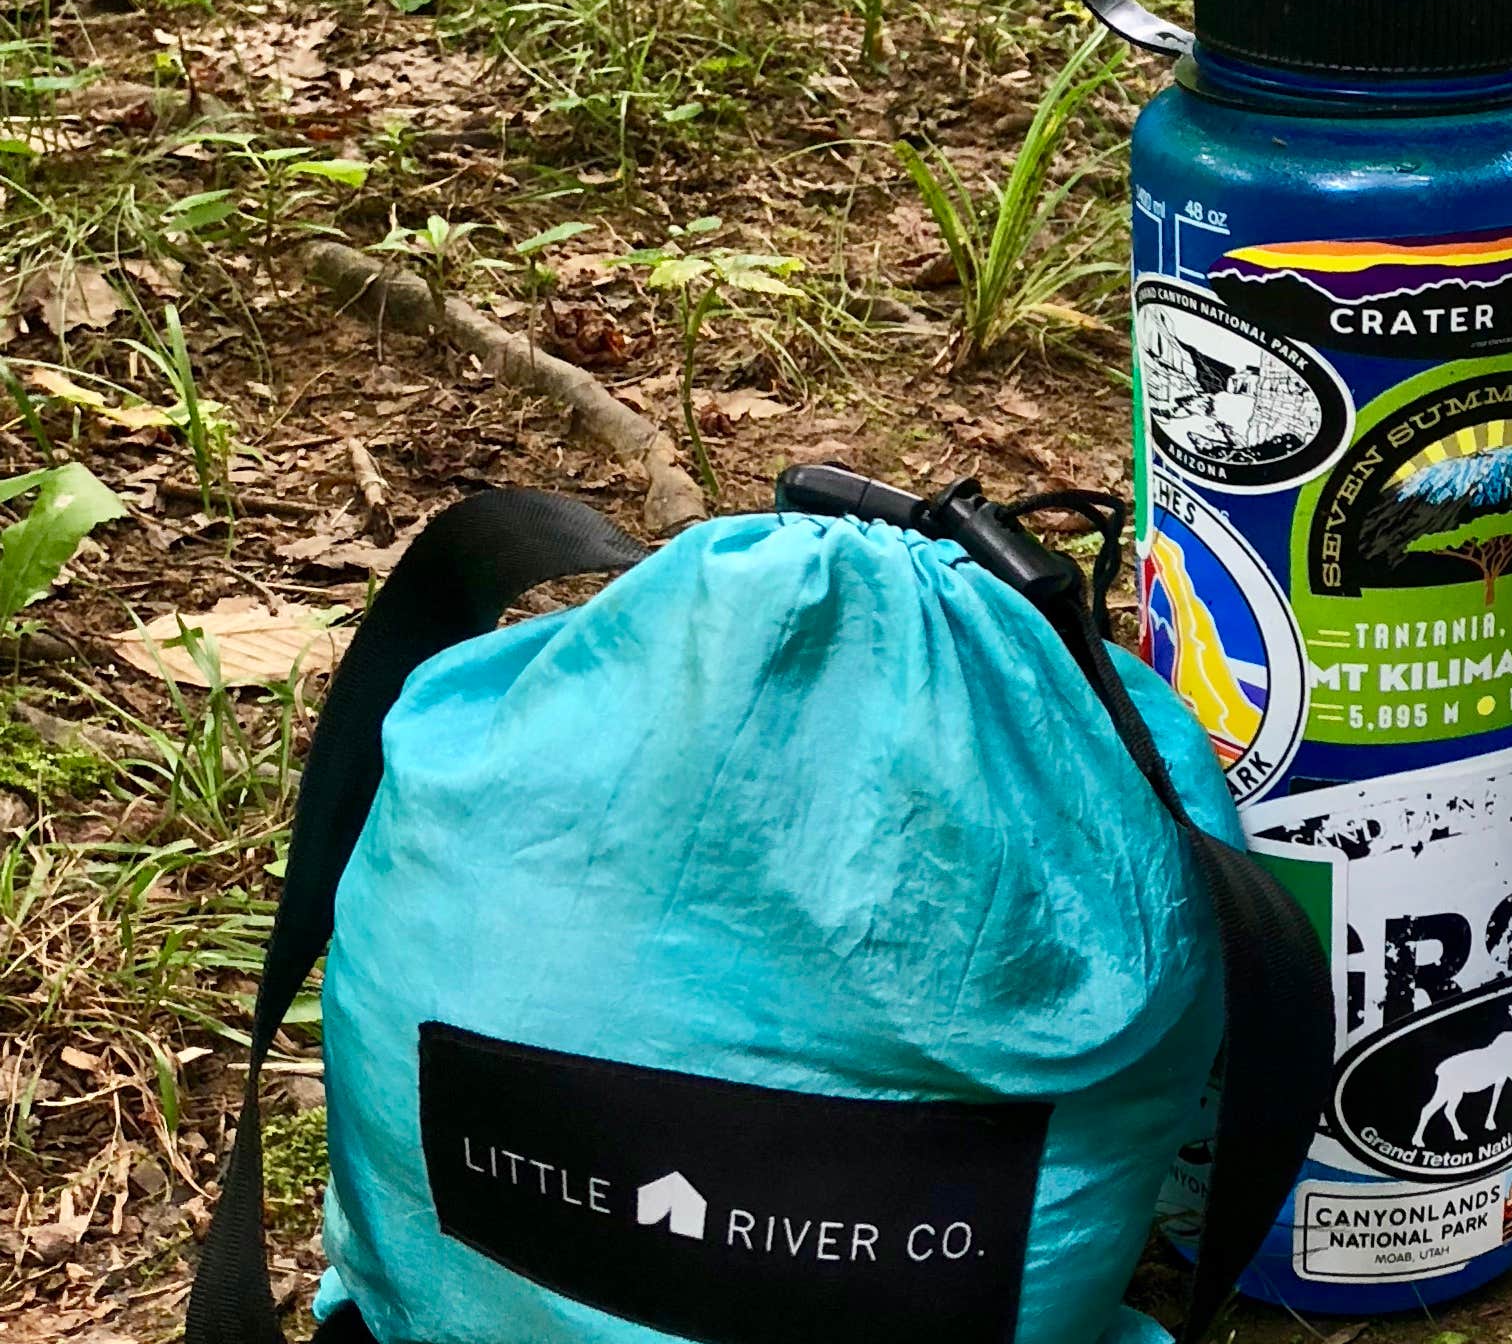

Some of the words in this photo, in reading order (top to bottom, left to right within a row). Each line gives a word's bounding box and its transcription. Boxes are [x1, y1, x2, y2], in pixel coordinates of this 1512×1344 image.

[1184, 199, 1204, 222] 48
[1158, 287, 1198, 311] CANYON
[1200, 305, 1268, 345] NATIONAL
[1270, 338, 1310, 372] PARK
[1329, 304, 1494, 336] CRATER
[1167, 443, 1228, 480] ARIZONA
[1156, 479, 1197, 525] HES
[1322, 444, 1385, 588] SEVEN
[1355, 611, 1506, 649] TANZANIA,
[1308, 659, 1369, 692] MT
[1443, 701, 1460, 725] M
[1226, 751, 1274, 797] ARK
[1360, 1126, 1418, 1165] Grand
[1422, 1150, 1474, 1168] Teton
[463, 1136, 611, 1215] LITTLE
[726, 1208, 880, 1261] RIVER
[906, 1221, 985, 1262] CO.
[1315, 1184, 1501, 1228] CANYONLANDS
[1329, 1228, 1433, 1250] NATIONAL
[1441, 1212, 1489, 1241] PARK
[1374, 1252, 1416, 1265] MOAB,
[1419, 1245, 1451, 1260] UTAH
